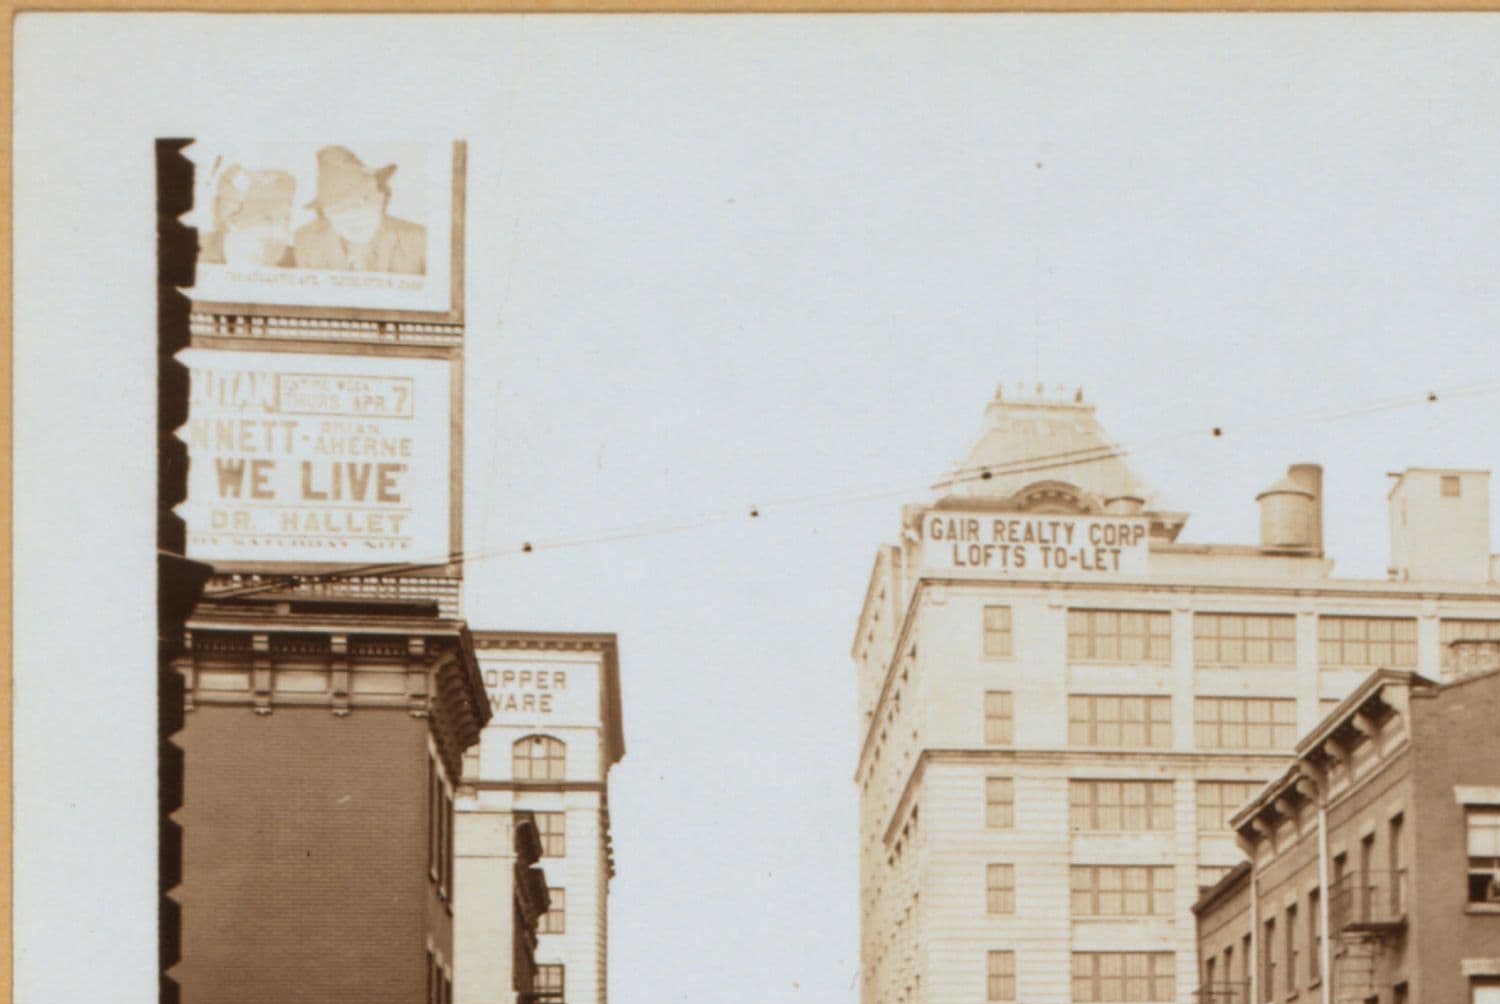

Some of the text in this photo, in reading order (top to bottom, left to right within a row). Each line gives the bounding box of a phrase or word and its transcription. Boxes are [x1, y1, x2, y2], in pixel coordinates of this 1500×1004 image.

[391, 385, 409, 413] 7
[313, 434, 414, 458] AHERNE
[214, 457, 276, 500] WE
[279, 510, 406, 534] HALLET
[929, 517, 1146, 548] GAIR REALTY CORP
[952, 543, 1122, 572] LOFTS TO-LET
[485, 669, 568, 690] OPPER
[488, 692, 553, 713] WARE
